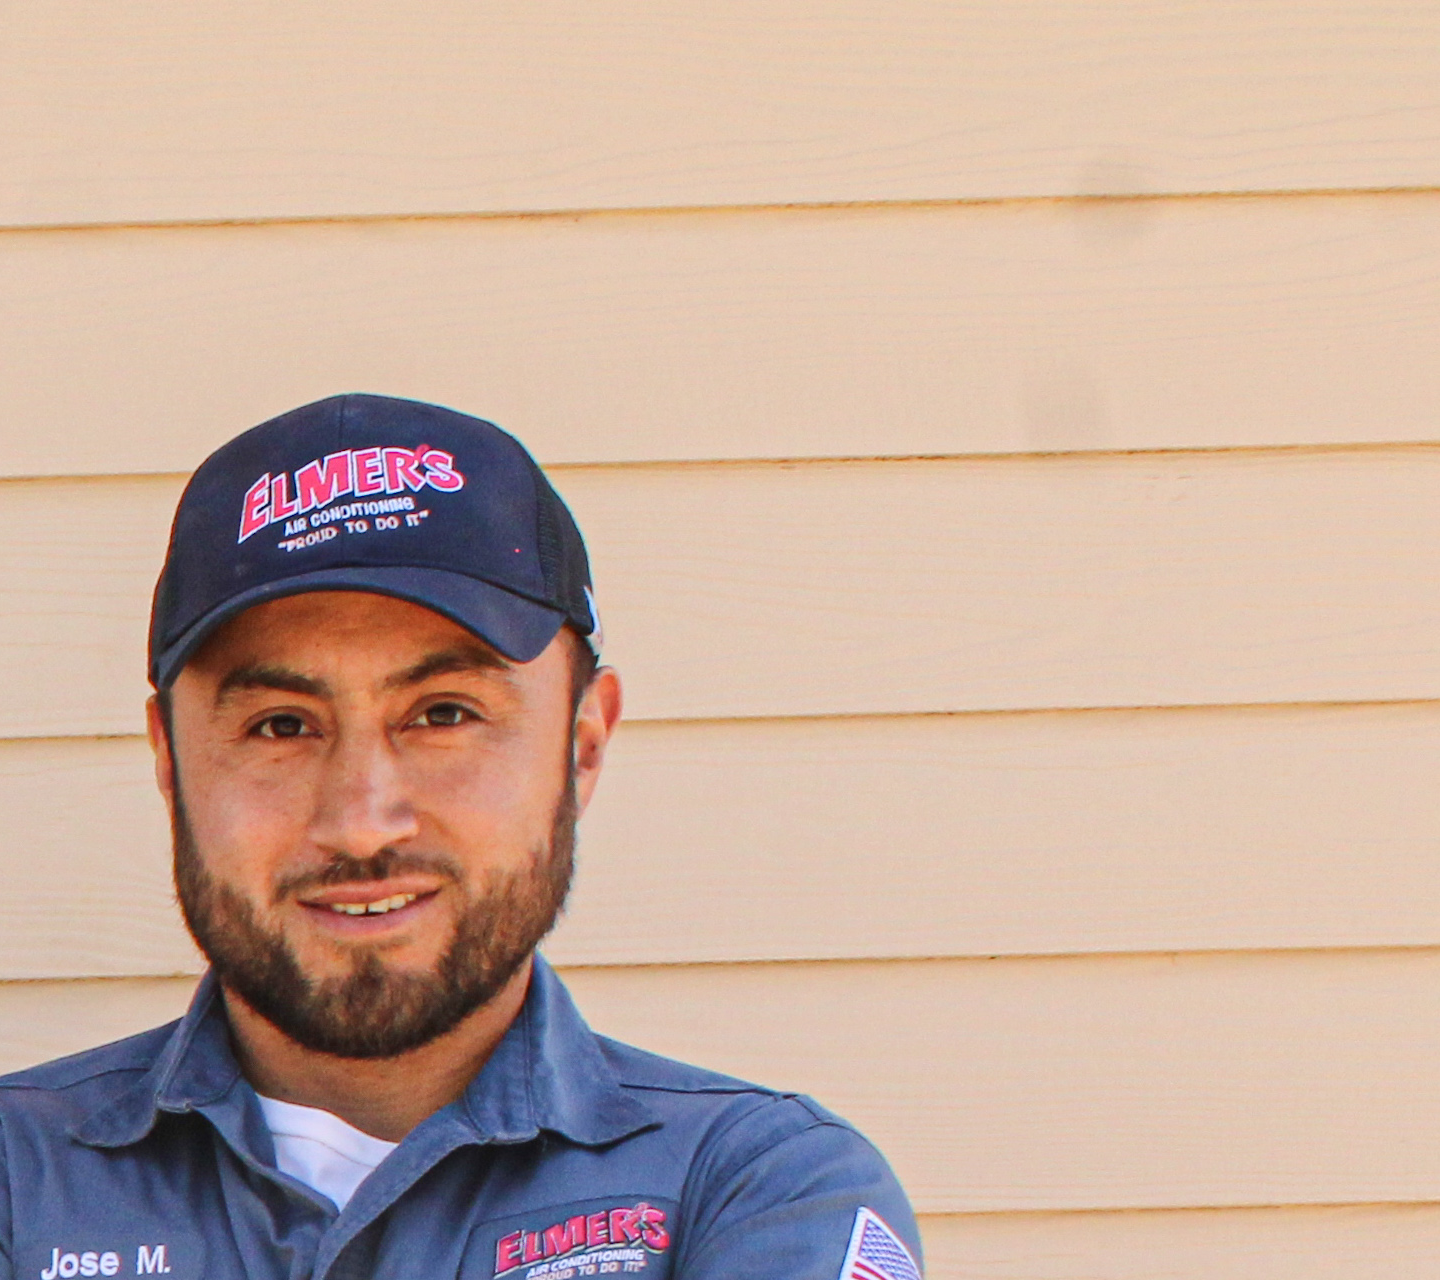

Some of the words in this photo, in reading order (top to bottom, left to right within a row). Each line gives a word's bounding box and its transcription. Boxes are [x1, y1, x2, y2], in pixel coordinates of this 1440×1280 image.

[238, 444, 465, 545] ELMER'S
[278, 527, 339, 552] "PROUD
[344, 519, 369, 534] TO
[375, 515, 400, 531] DO
[284, 515, 308, 537] AIR
[309, 496, 416, 527] CONDITIONING
[136, 1244, 171, 1275] M.
[493, 1202, 671, 1280] ELMER'S
[525, 1263, 551, 1279] AIR
[550, 1249, 646, 1272] CONDITIONING
[578, 1264, 597, 1276] TO
[599, 1261, 620, 1274] DO
